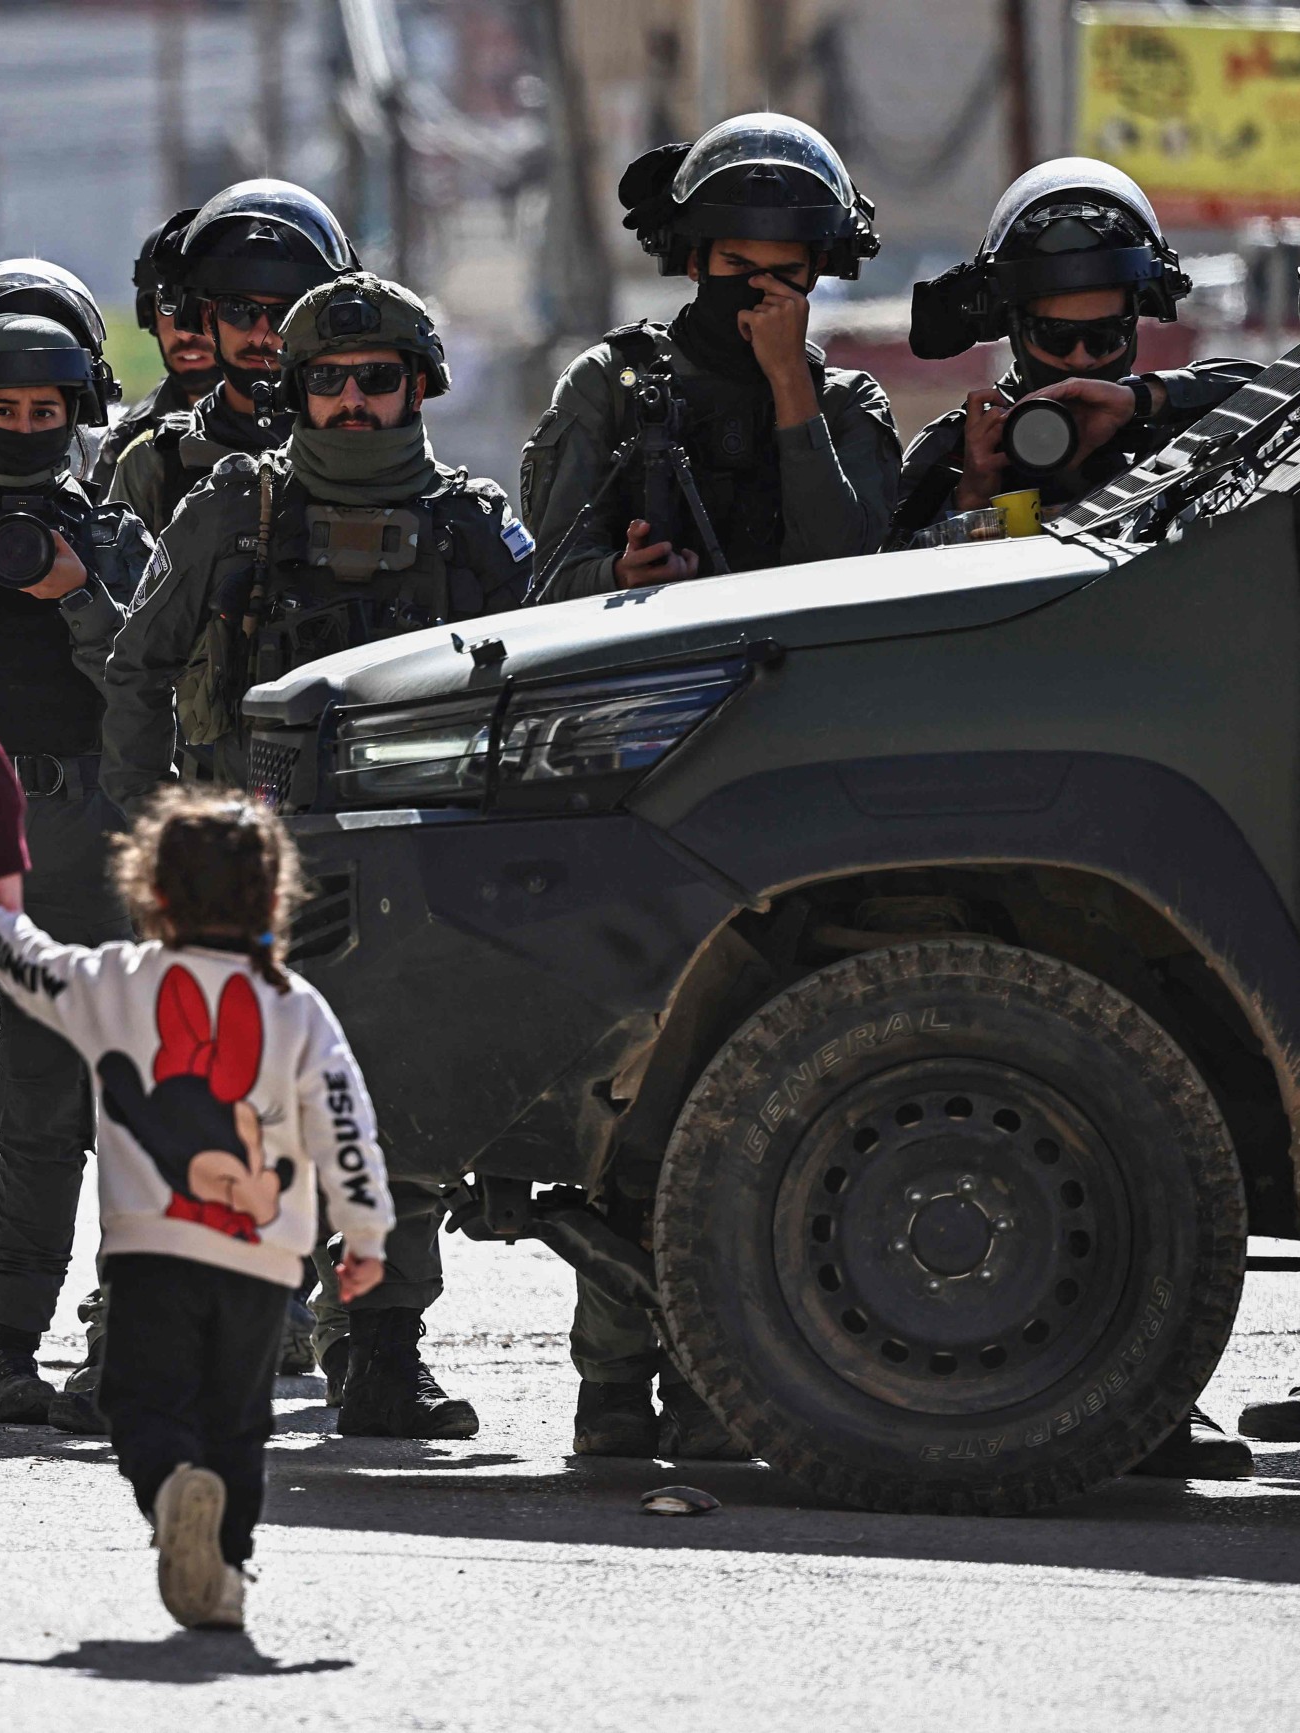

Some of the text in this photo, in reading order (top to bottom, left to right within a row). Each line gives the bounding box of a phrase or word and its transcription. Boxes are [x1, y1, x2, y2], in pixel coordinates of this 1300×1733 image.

[322, 1069, 378, 1210] MOUSE
[741, 1006, 952, 1166] GENERAL
[918, 1274, 1175, 1463] GRABBER AT3
